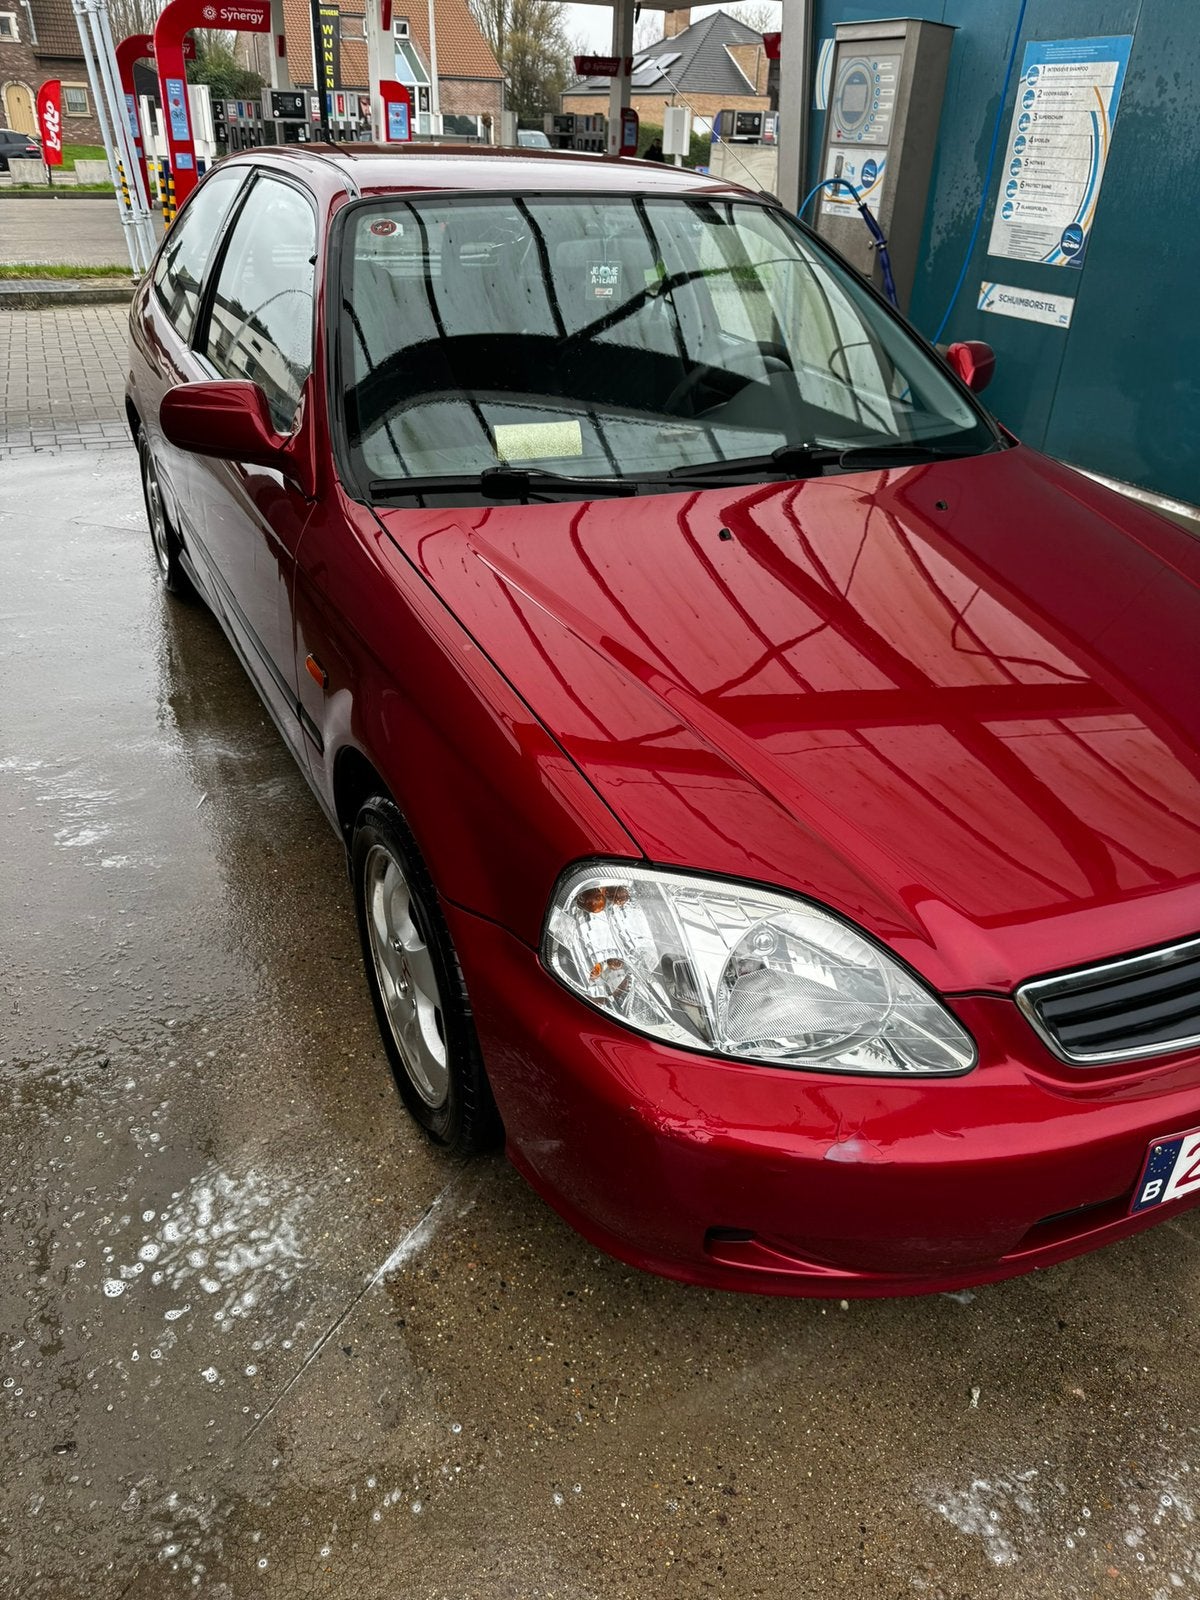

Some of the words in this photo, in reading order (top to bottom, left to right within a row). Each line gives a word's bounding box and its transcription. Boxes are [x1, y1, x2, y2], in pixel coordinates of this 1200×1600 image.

[220, 8, 264, 24] Synergy
[322, 24, 334, 88] WIJNEN
[216, 104, 221, 112] 2
[295, 97, 302, 107] 6
[43, 100, 61, 152] Lotto
[998, 293, 1057, 313] SCHUIMBORSTEL
[1140, 1178, 1163, 1203] B
